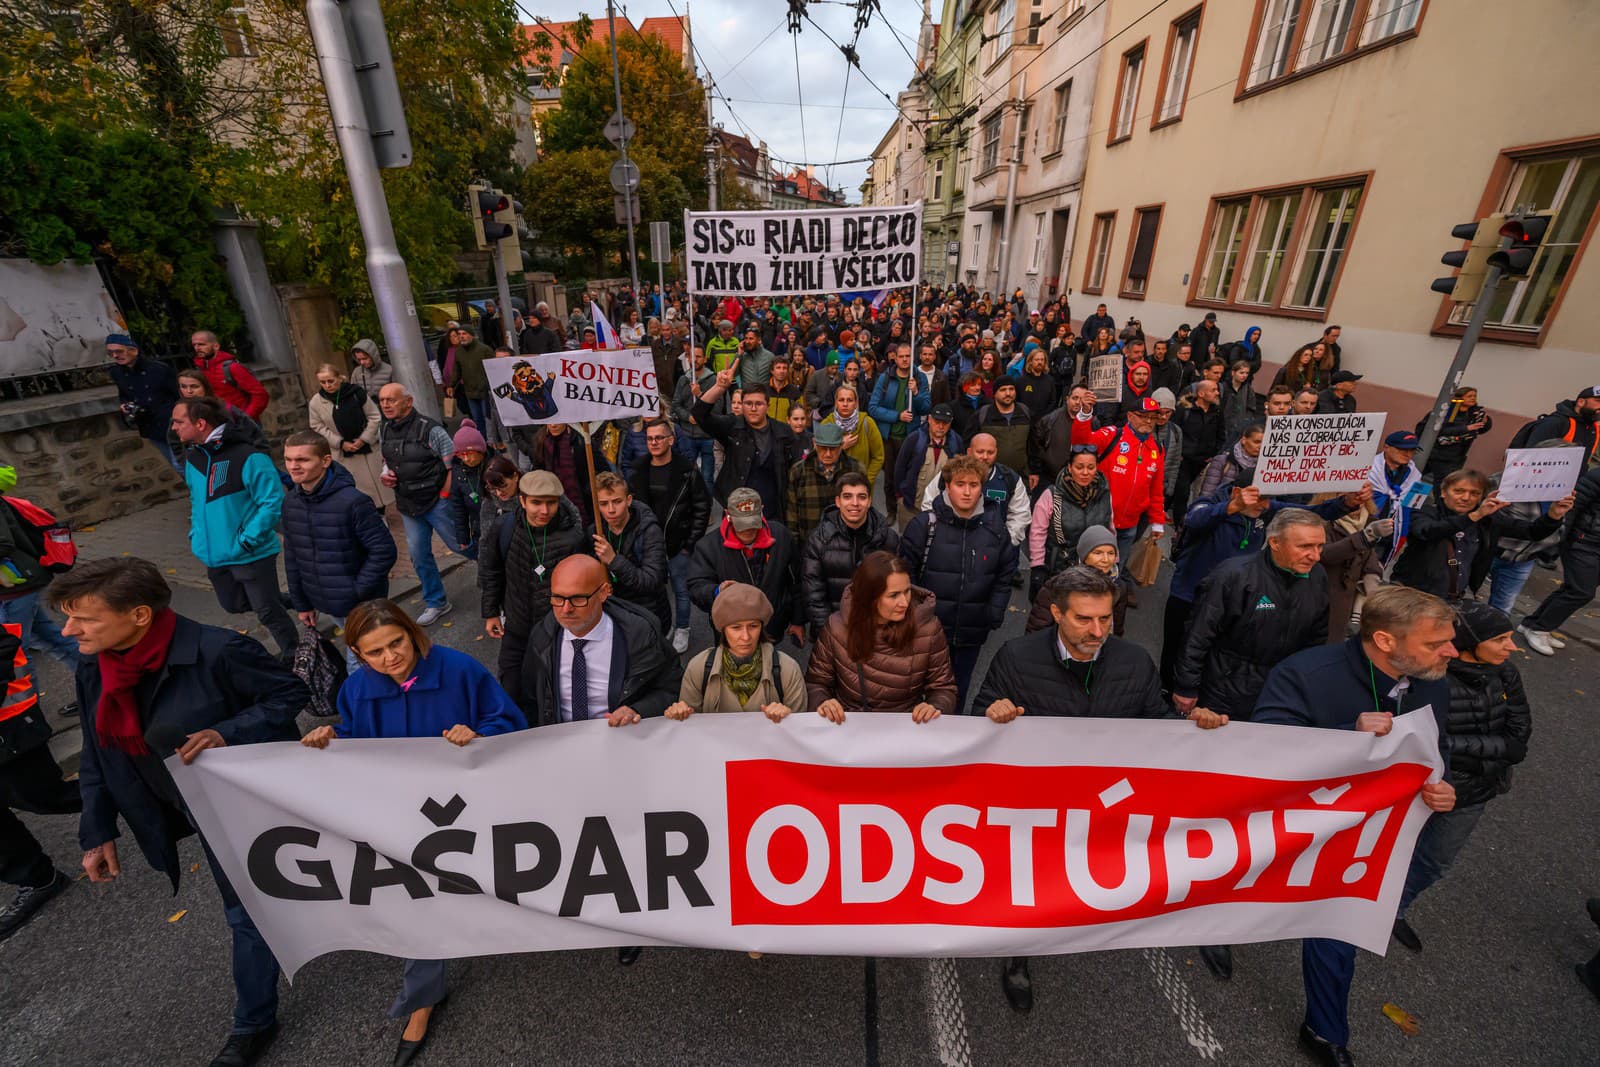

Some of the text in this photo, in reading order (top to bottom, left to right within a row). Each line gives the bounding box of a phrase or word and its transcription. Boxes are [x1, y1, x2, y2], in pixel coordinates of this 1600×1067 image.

[763, 217, 832, 254] RIADI
[842, 212, 918, 252] DECKO
[691, 251, 916, 291] TATKO ŽEHLÍ VŠECKO
[559, 358, 657, 391] KONIEC
[563, 381, 660, 412] BALADY
[1271, 414, 1366, 430] VAŠA KONSOLIDÁCIA
[1269, 430, 1291, 444] NÁS
[1262, 444, 1277, 457] UŽ
[1278, 445, 1300, 457] LEN
[1267, 457, 1330, 470] MALÝ DVOR.
[1312, 470, 1327, 482] NA
[247, 776, 1395, 918] GAŠPAR ODSTÚPIŤ!
